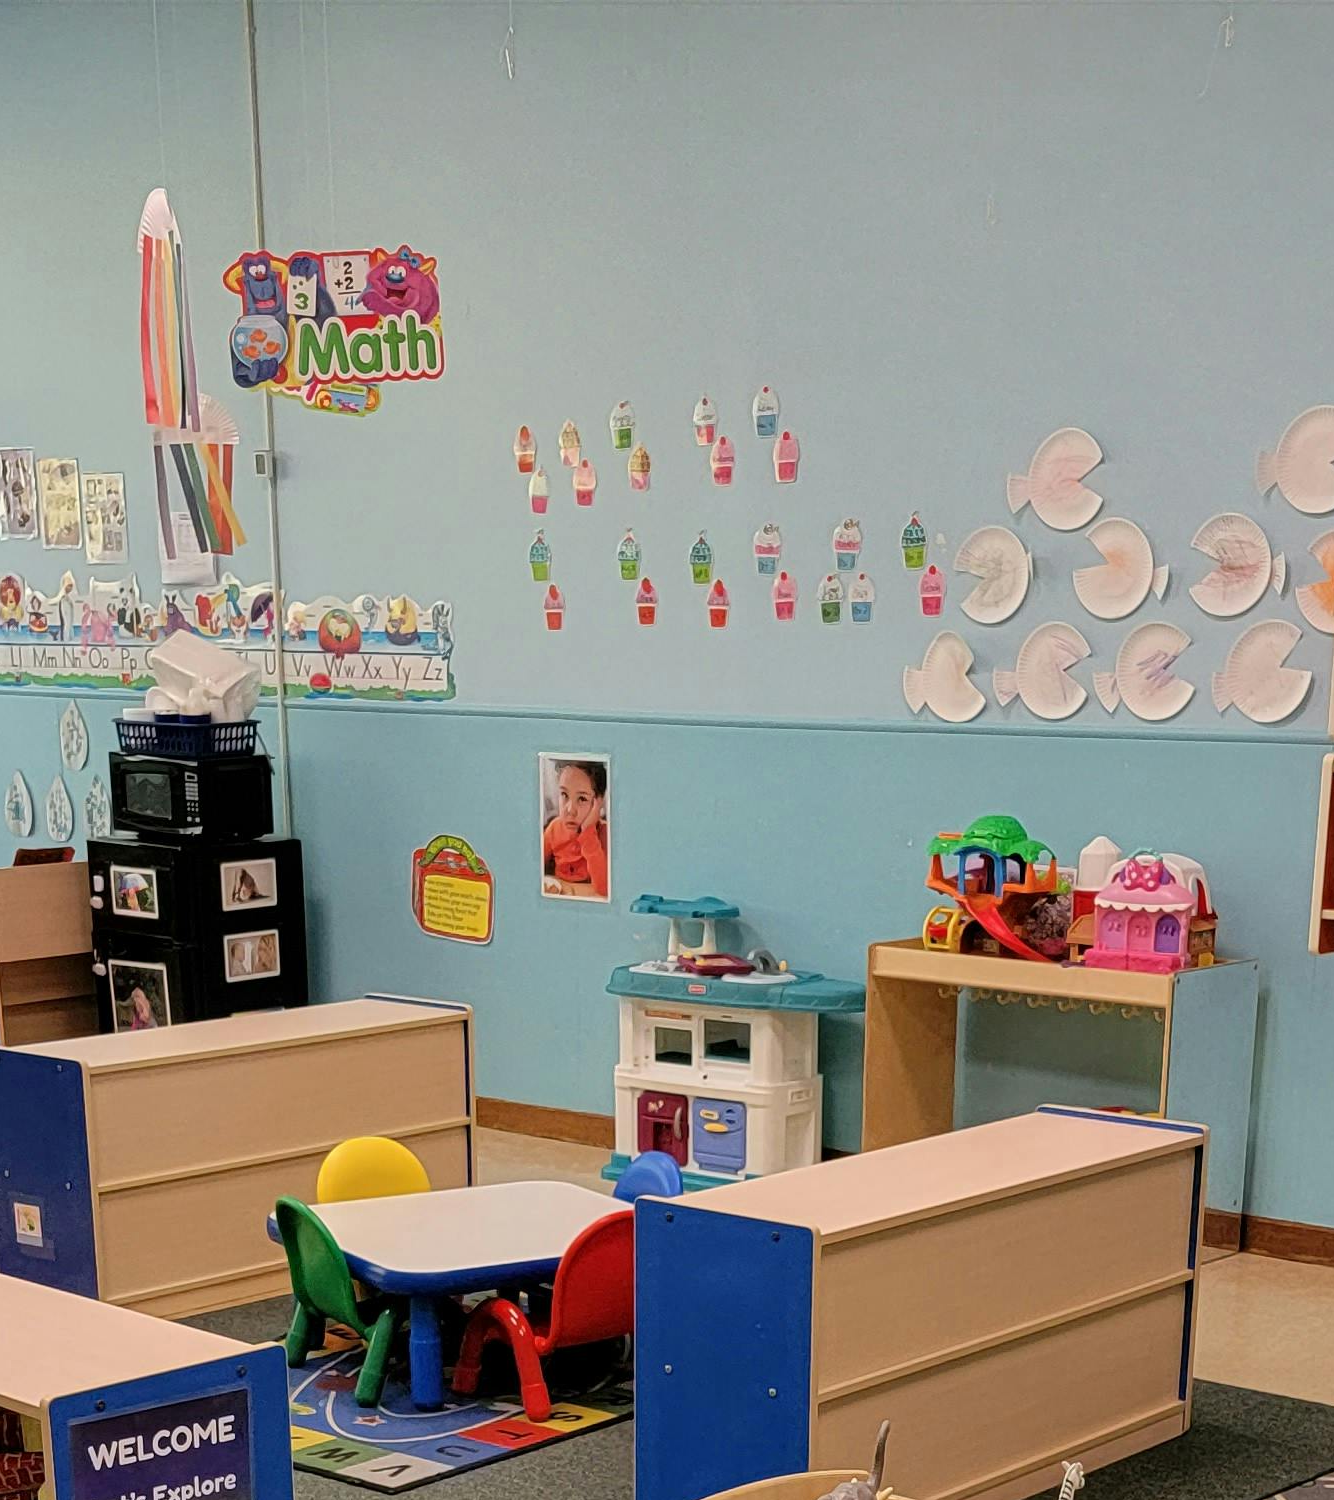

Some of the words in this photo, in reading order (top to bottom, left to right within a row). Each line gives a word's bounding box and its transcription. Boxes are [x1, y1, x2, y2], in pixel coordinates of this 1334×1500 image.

[343, 260, 353, 275] 2
[293, 292, 309, 310] 3
[298, 314, 437, 376] Math
[33, 647, 57, 668] Mm
[88, 647, 109, 669] Oo
[121, 648, 137, 676] Pp
[291, 654, 311, 677] Vv
[323, 654, 355, 679] Ww
[361, 655, 383, 680] Xx
[391, 656, 411, 690] Yy
[422, 656, 444, 681] Zz
[88, 1414, 236, 1471] WELCOME
